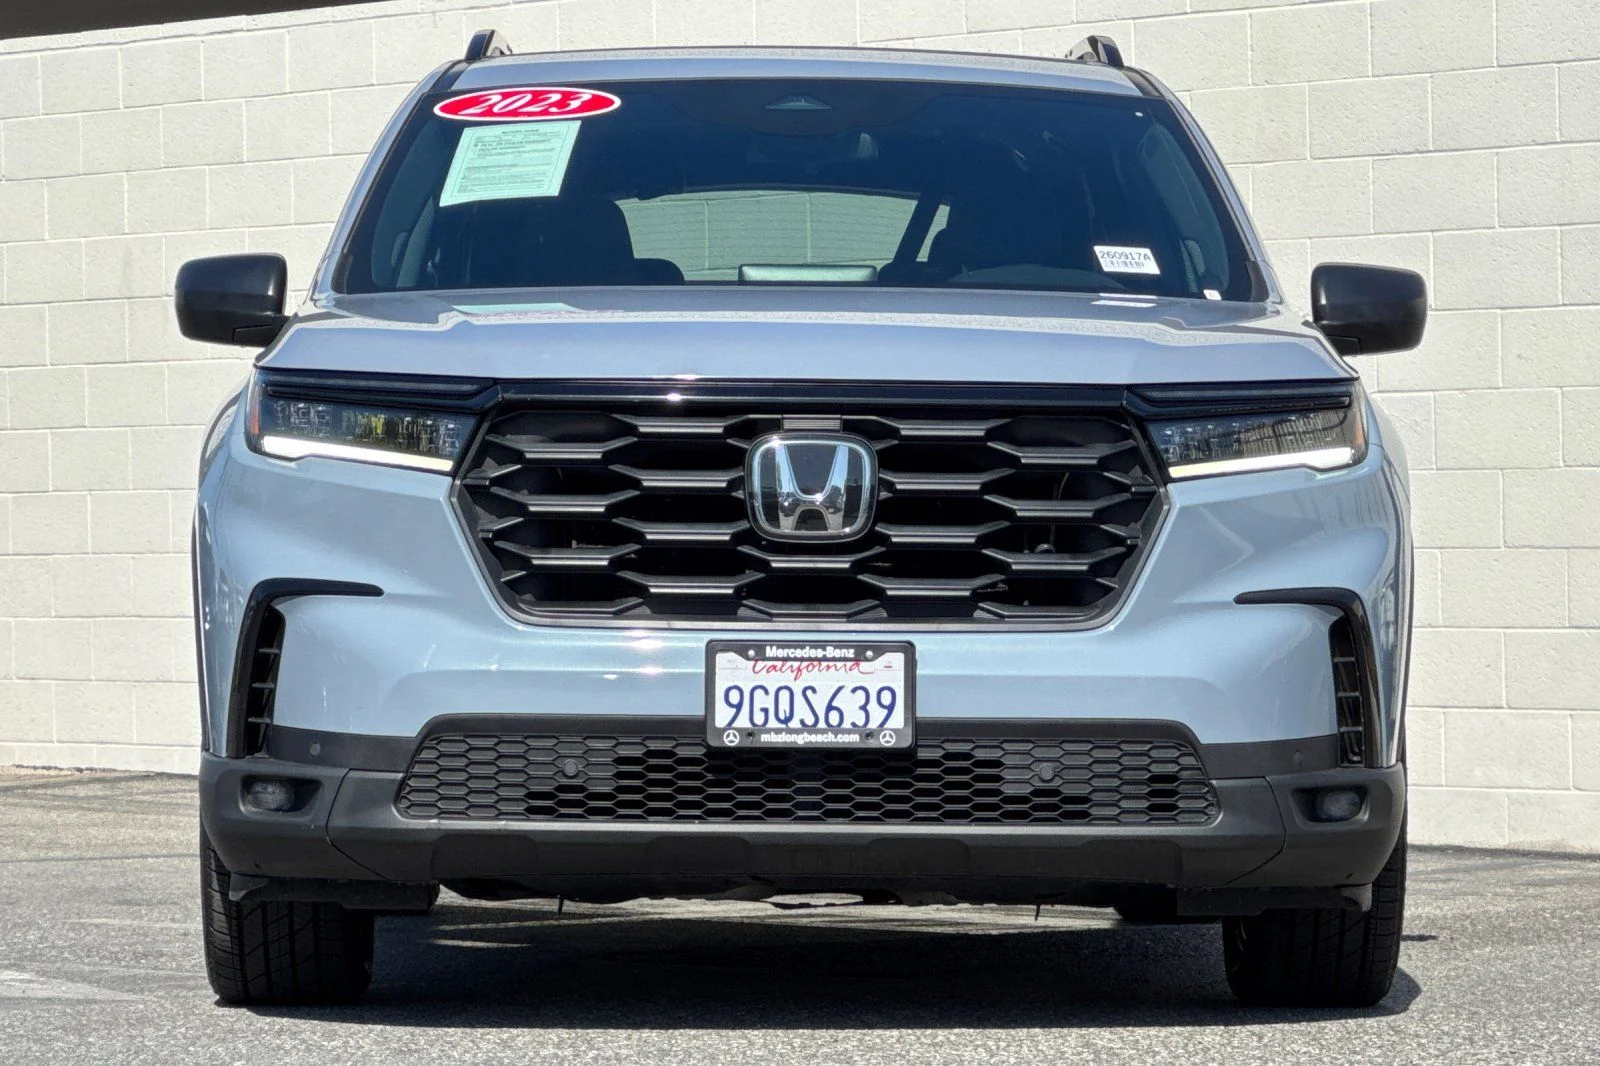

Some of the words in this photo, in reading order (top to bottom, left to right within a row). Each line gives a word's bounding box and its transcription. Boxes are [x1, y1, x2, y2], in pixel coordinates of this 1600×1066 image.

[458, 92, 592, 115] 2023
[1099, 250, 1152, 262] 260917A
[765, 646, 855, 658] Mercedes-Benz
[752, 659, 874, 681] California
[723, 684, 897, 729] 9GQS639
[760, 732, 860, 744] mbzlongbeach.com
